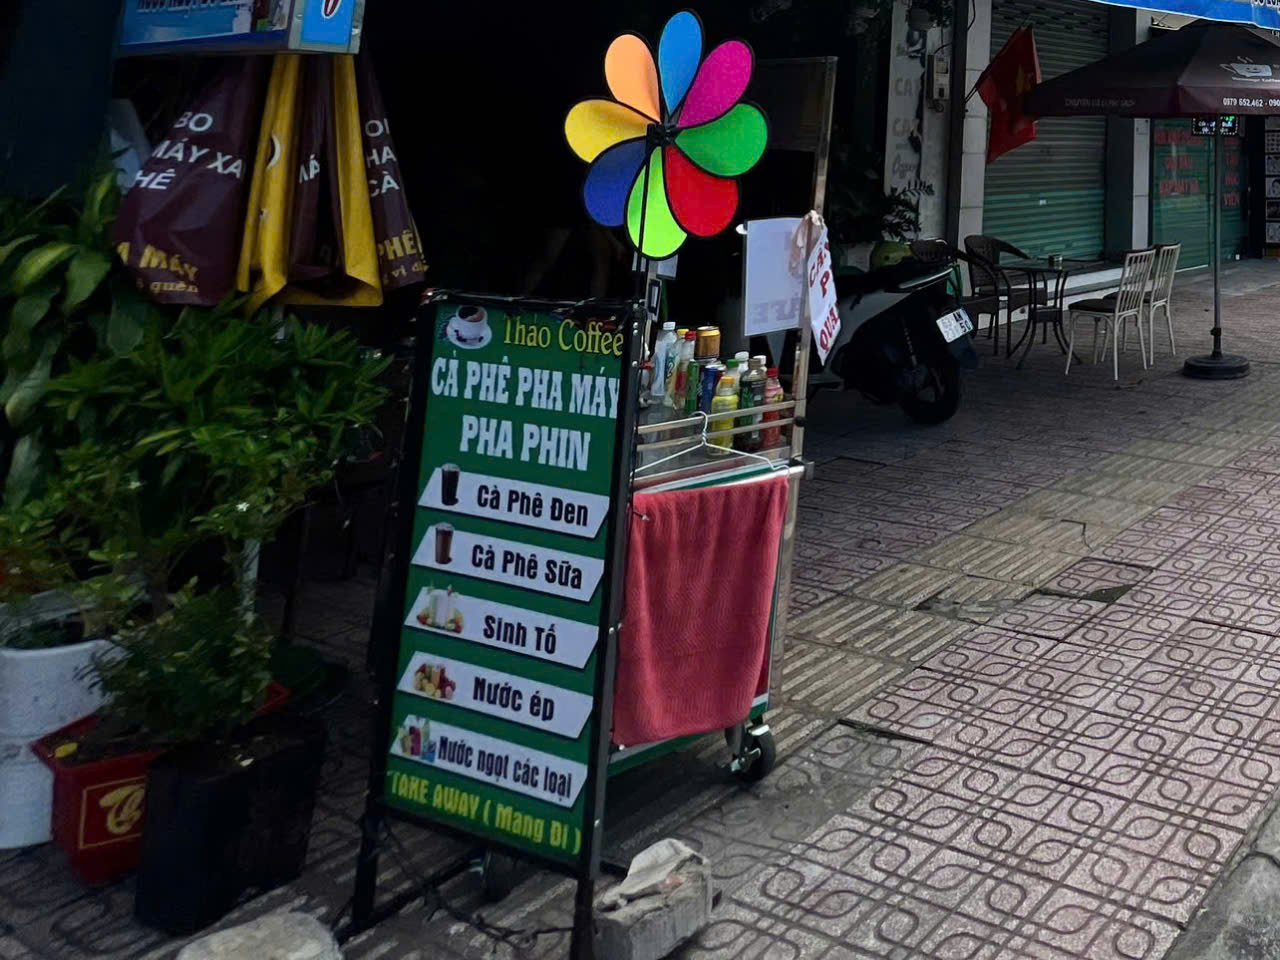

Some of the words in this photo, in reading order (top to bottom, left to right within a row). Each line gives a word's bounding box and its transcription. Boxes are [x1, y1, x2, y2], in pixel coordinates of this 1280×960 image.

[558, 319, 625, 356] Coffee
[464, 356, 511, 404] PHÊ
[515, 367, 563, 411] PHA
[568, 367, 620, 419] MÁY
[459, 414, 513, 460] PHA
[520, 423, 591, 471] PHIN
[477, 485, 500, 510] Cà
[507, 490, 543, 518] Phê
[550, 497, 588, 526] Đen
[471, 544, 495, 570] Cà
[502, 550, 538, 579] Phê
[545, 557, 582, 589] Sữa
[483, 614, 527, 648] Sinh
[534, 623, 557, 654] Tố
[472, 675, 523, 713] Nước
[530, 688, 555, 721] ép
[438, 736, 473, 768] Nước
[477, 746, 509, 783] ngọt
[513, 758, 539, 786] các
[543, 764, 573, 802] loại
[432, 782, 481, 821] AWAY
[495, 802, 545, 845] Mang
